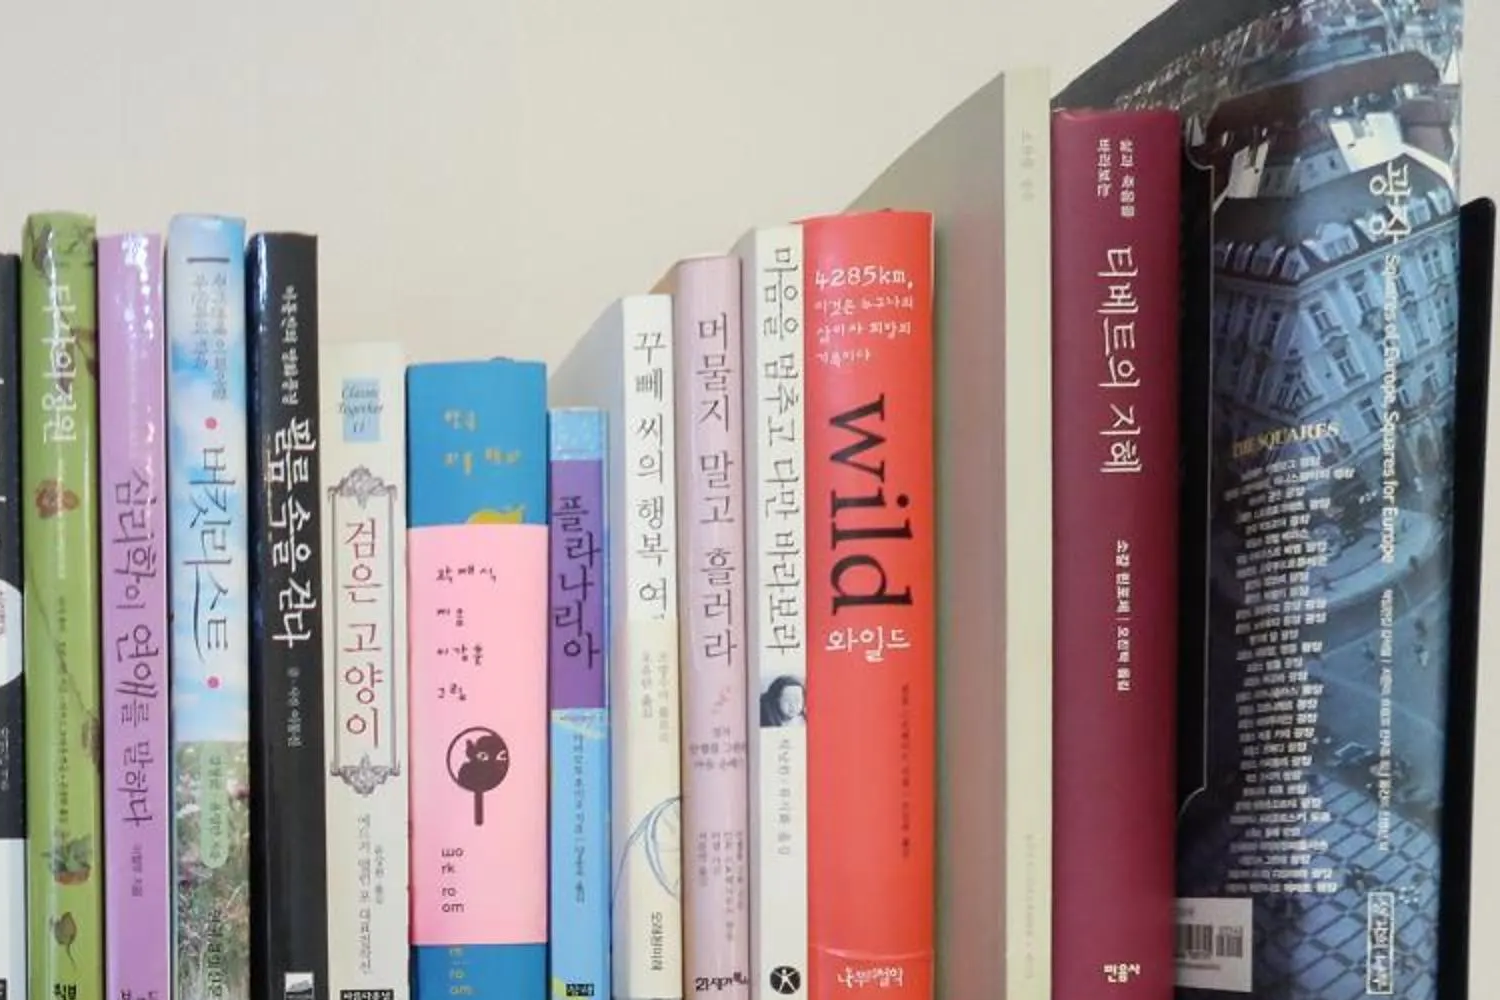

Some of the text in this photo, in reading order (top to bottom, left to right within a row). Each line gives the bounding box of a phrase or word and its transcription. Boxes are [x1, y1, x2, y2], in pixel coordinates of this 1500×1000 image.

[1096, 138, 1112, 198] 바라보는
[1119, 139, 1136, 218] 삶과 죽음을
[1369, 163, 1411, 245] 광장
[814, 299, 856, 316] 이것은
[633, 332, 667, 401] 꾸뻬
[1096, 246, 1143, 474] 티베트의 지혜
[637, 413, 664, 484] 씨의
[763, 246, 801, 656] 마음을 멈추고 다만 바라보라
[1380, 410, 1400, 476] Squares
[697, 312, 739, 667] 머물지 말고 흘러라
[1382, 480, 1400, 503] for
[267, 416, 316, 650] 필름 속을 걷다
[636, 494, 669, 567] 행복
[1379, 506, 1400, 563] Europe
[552, 496, 603, 669] 플라나리아
[112, 468, 160, 827] 심리학이 연애를 말하다
[343, 518, 384, 748] 검은 고양이
[825, 627, 912, 662] 와일드
[441, 863, 455, 875] rk
[442, 887, 457, 897] ro
[441, 903, 465, 913] om
[1103, 963, 1141, 983] 민음사
